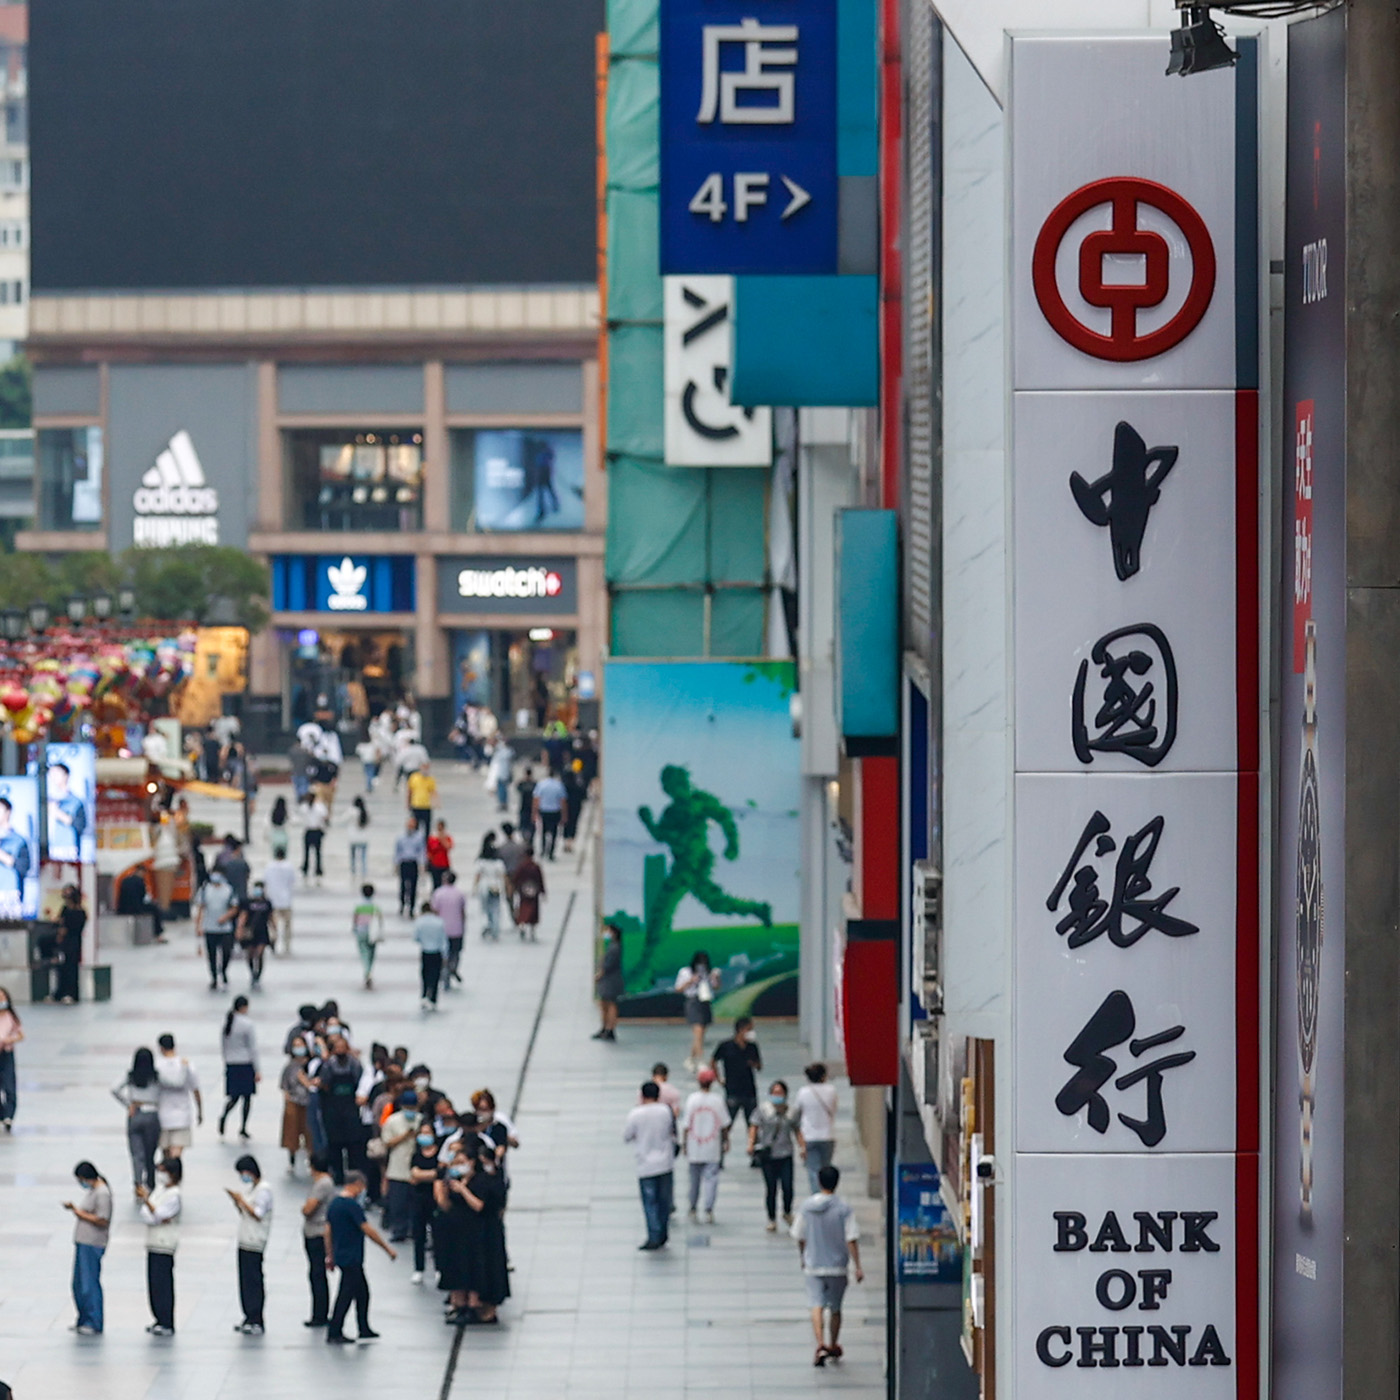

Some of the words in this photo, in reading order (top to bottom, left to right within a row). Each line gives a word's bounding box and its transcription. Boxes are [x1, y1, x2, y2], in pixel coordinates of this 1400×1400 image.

[696, 18, 798, 123] 店
[689, 172, 770, 222] 4F
[1303, 237, 1328, 305] TUDOR
[133, 486, 218, 515] adidas
[458, 566, 546, 598] swatch
[1053, 1211, 1221, 1253] BANK
[1095, 1268, 1173, 1310] OF
[1036, 1324, 1231, 1368] CHINA
